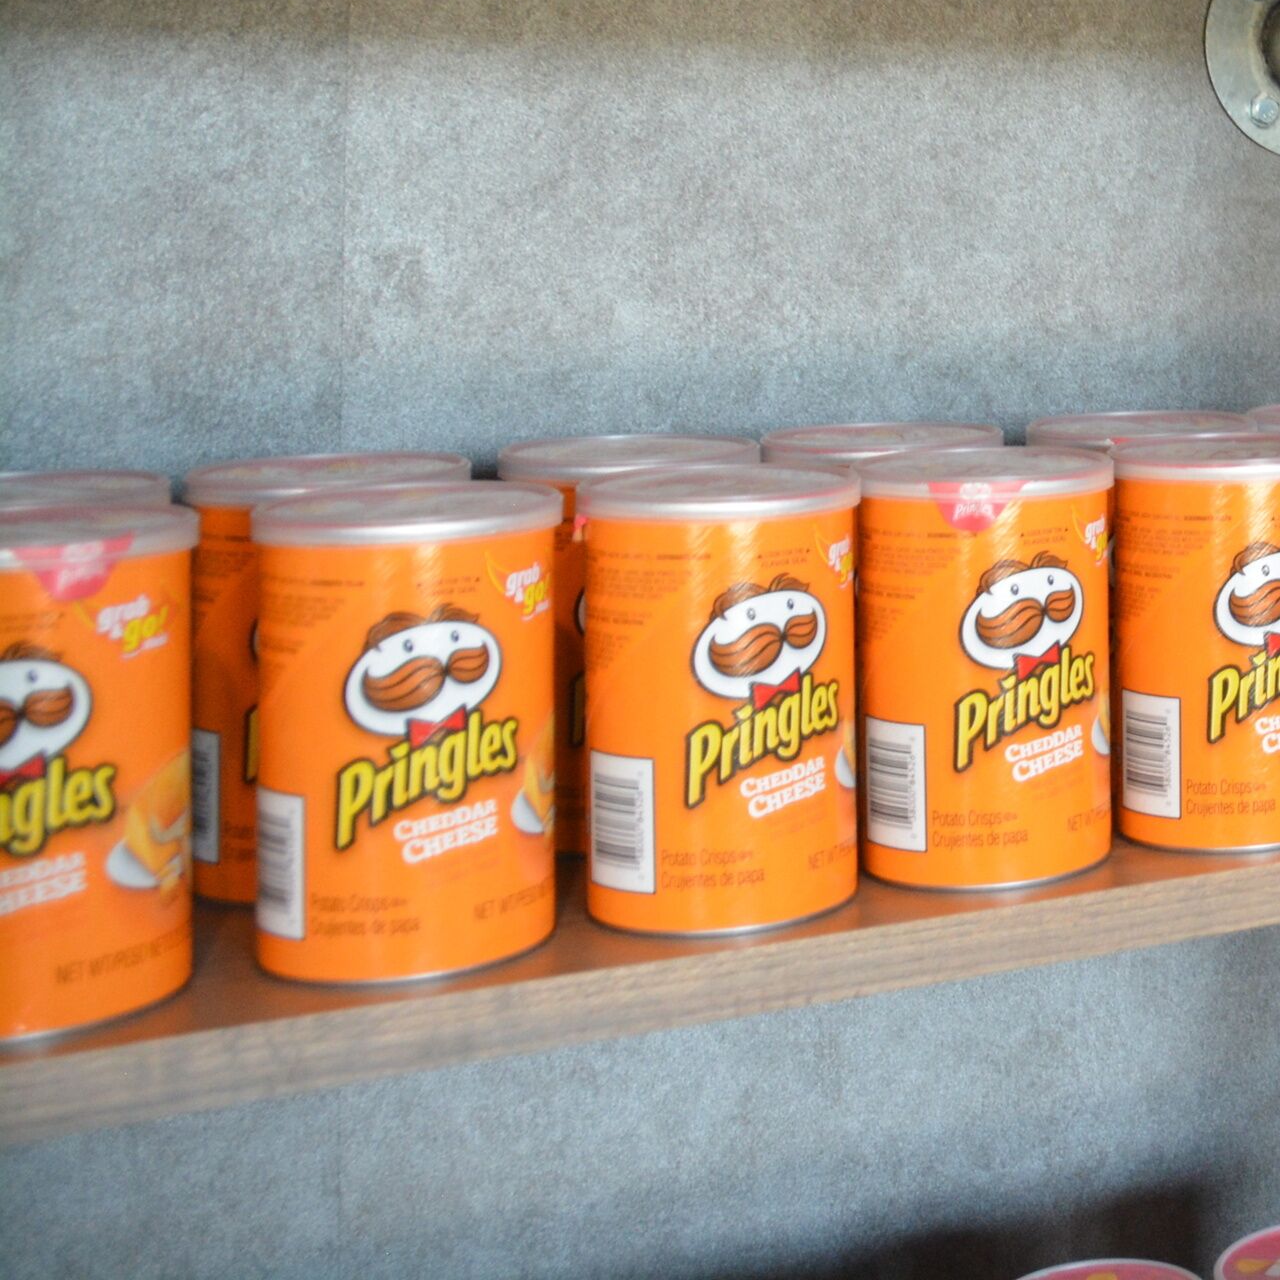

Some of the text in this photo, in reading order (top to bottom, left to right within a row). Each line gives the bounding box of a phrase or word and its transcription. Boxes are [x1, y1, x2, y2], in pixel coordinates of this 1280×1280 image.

[953, 644, 1096, 773] Pringles
[684, 671, 840, 810] Pringles
[1004, 724, 1083, 764] CHEDDAR
[334, 707, 519, 851] Pringles
[740, 755, 826, 798] CHEDDAR
[1011, 743, 1085, 785] CHEESE
[748, 776, 827, 819] CHEESE
[1186, 778, 1252, 799] Potato Crisps
[1236, 799, 1249, 815] de
[1252, 798, 1276, 818] papa
[393, 798, 498, 842] CHEDDAR
[401, 815, 500, 865] CHEESE
[0, 873, 88, 915] HEESE
